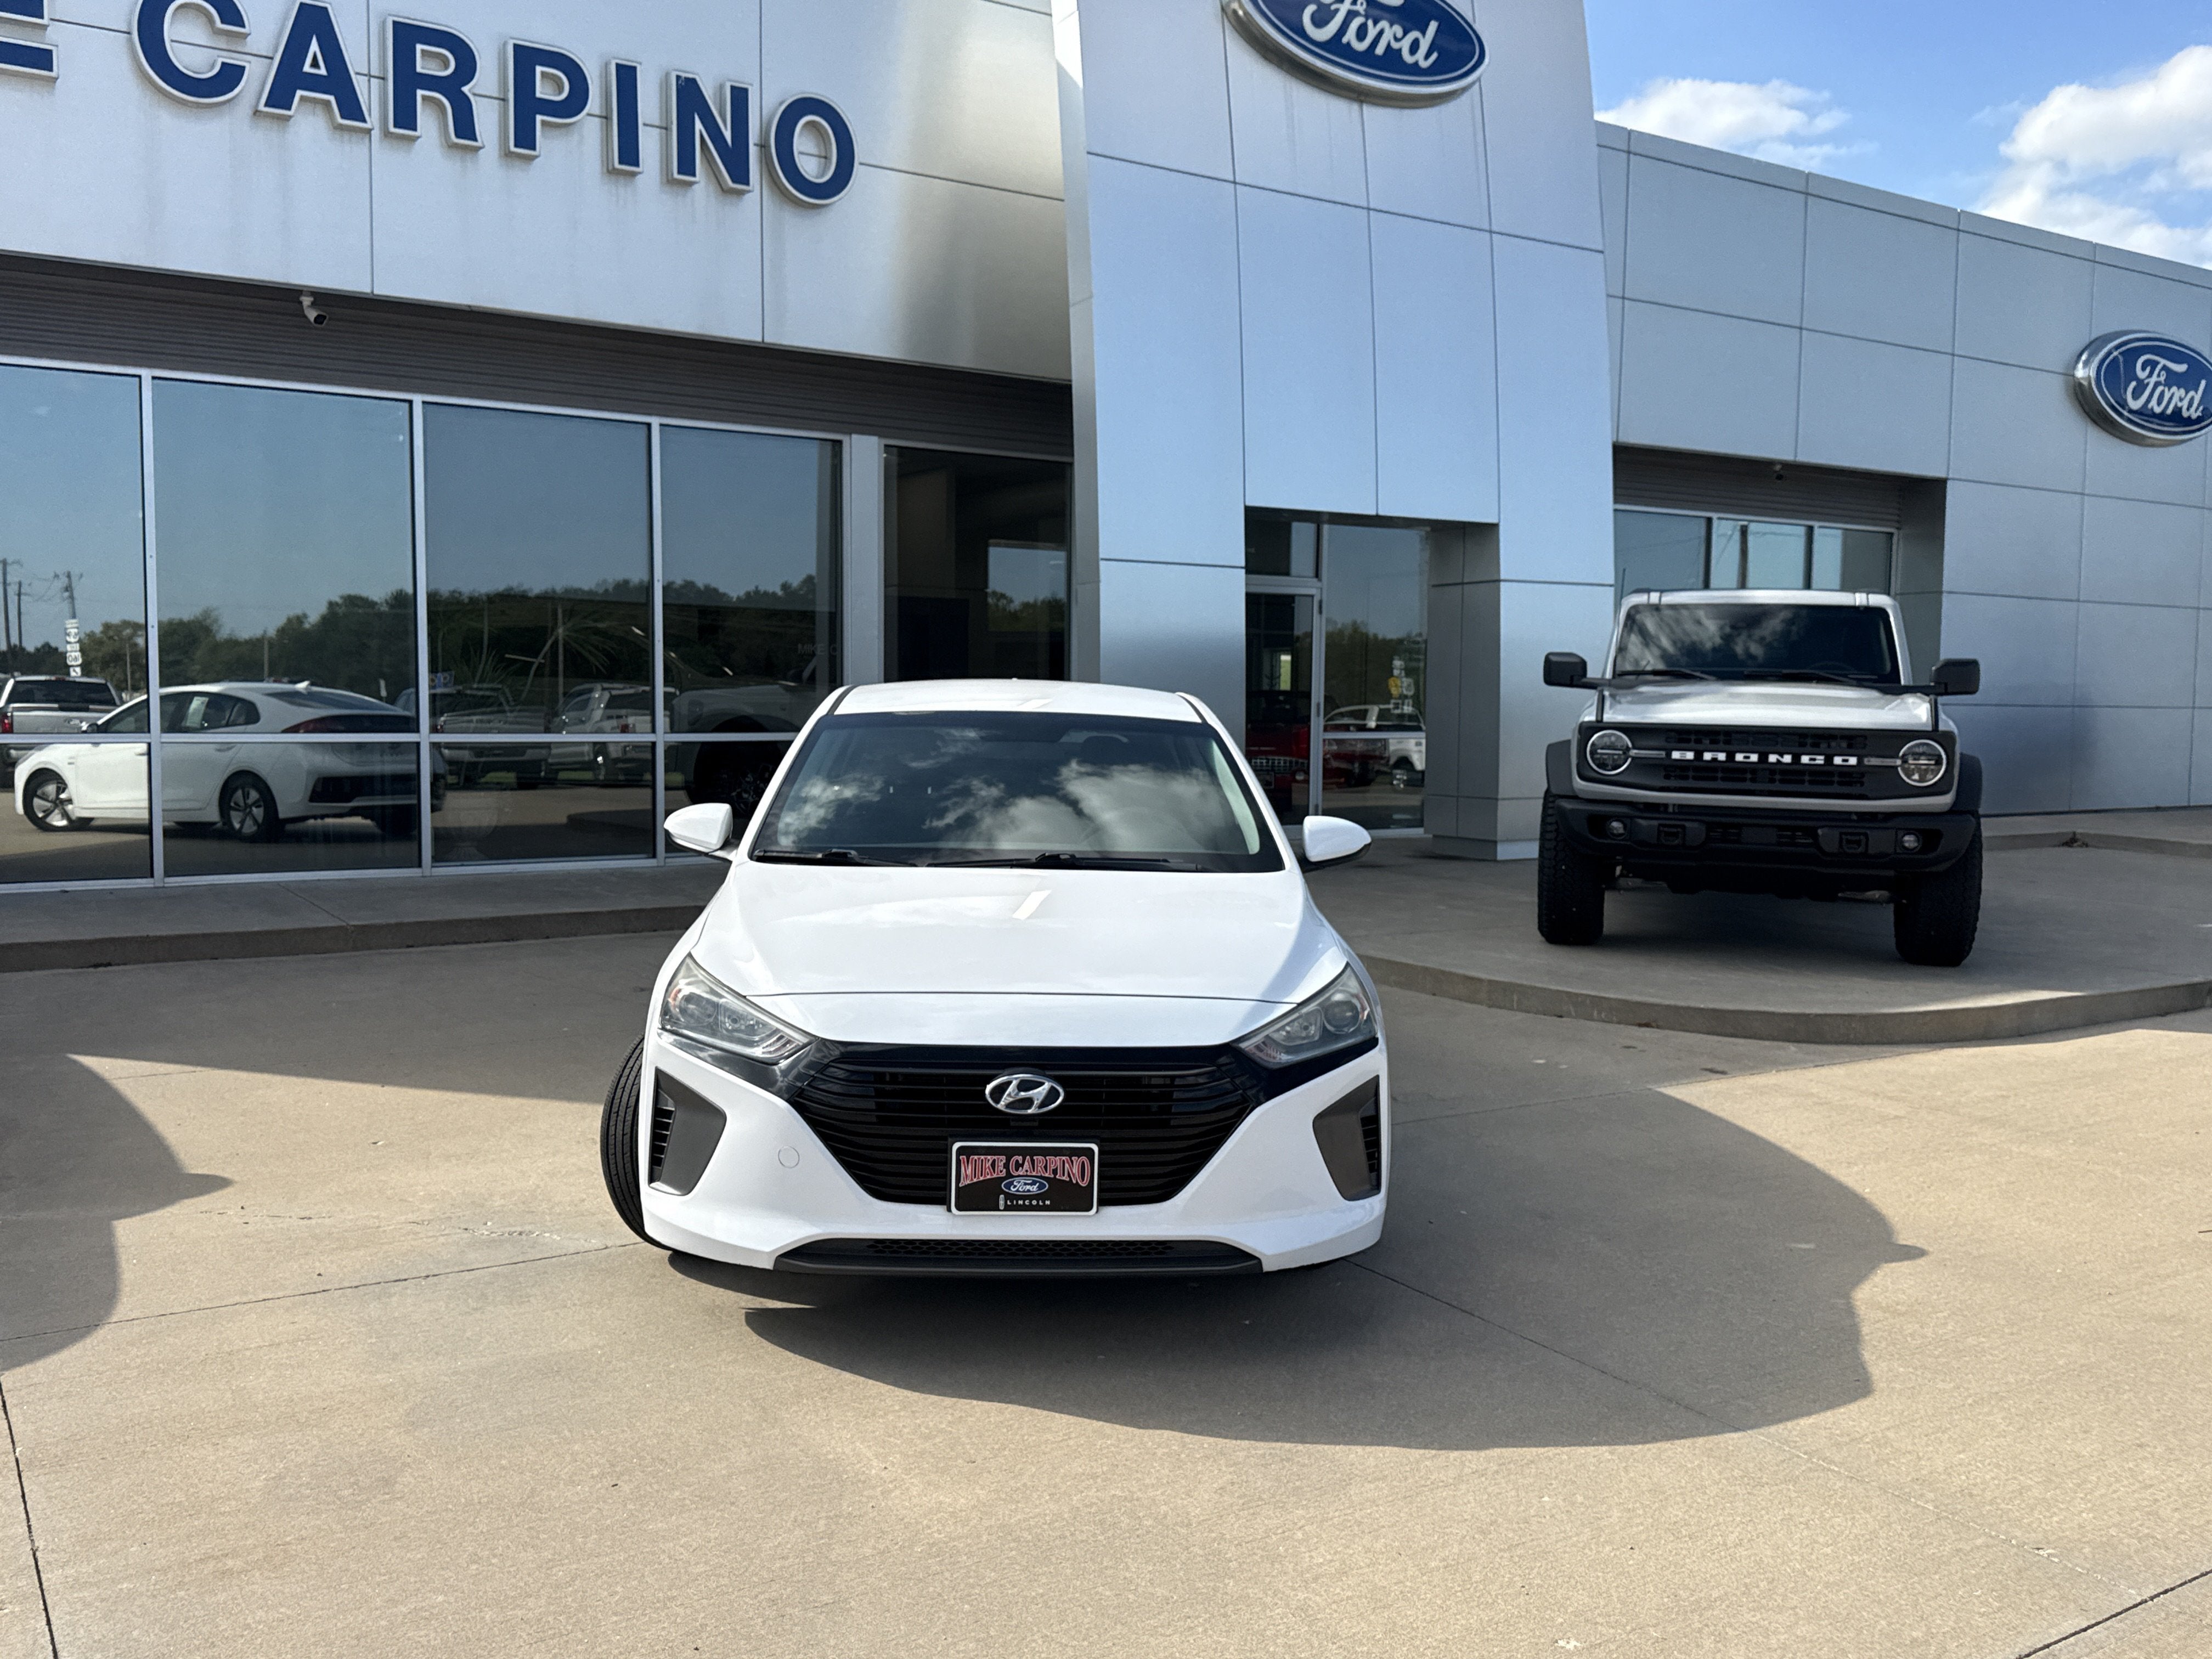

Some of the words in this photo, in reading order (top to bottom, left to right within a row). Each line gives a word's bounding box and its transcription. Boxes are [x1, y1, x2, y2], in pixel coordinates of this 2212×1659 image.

[1302, 0, 1438, 69] Ford
[131, 0, 857, 206] CARPINO
[2126, 354, 2207, 420] Ford
[1671, 751, 1858, 766] BRONCO
[959, 1155, 1006, 1187] MIKE
[1009, 1155, 1091, 1187] CARPINO
[1011, 1180, 1039, 1192] Ford
